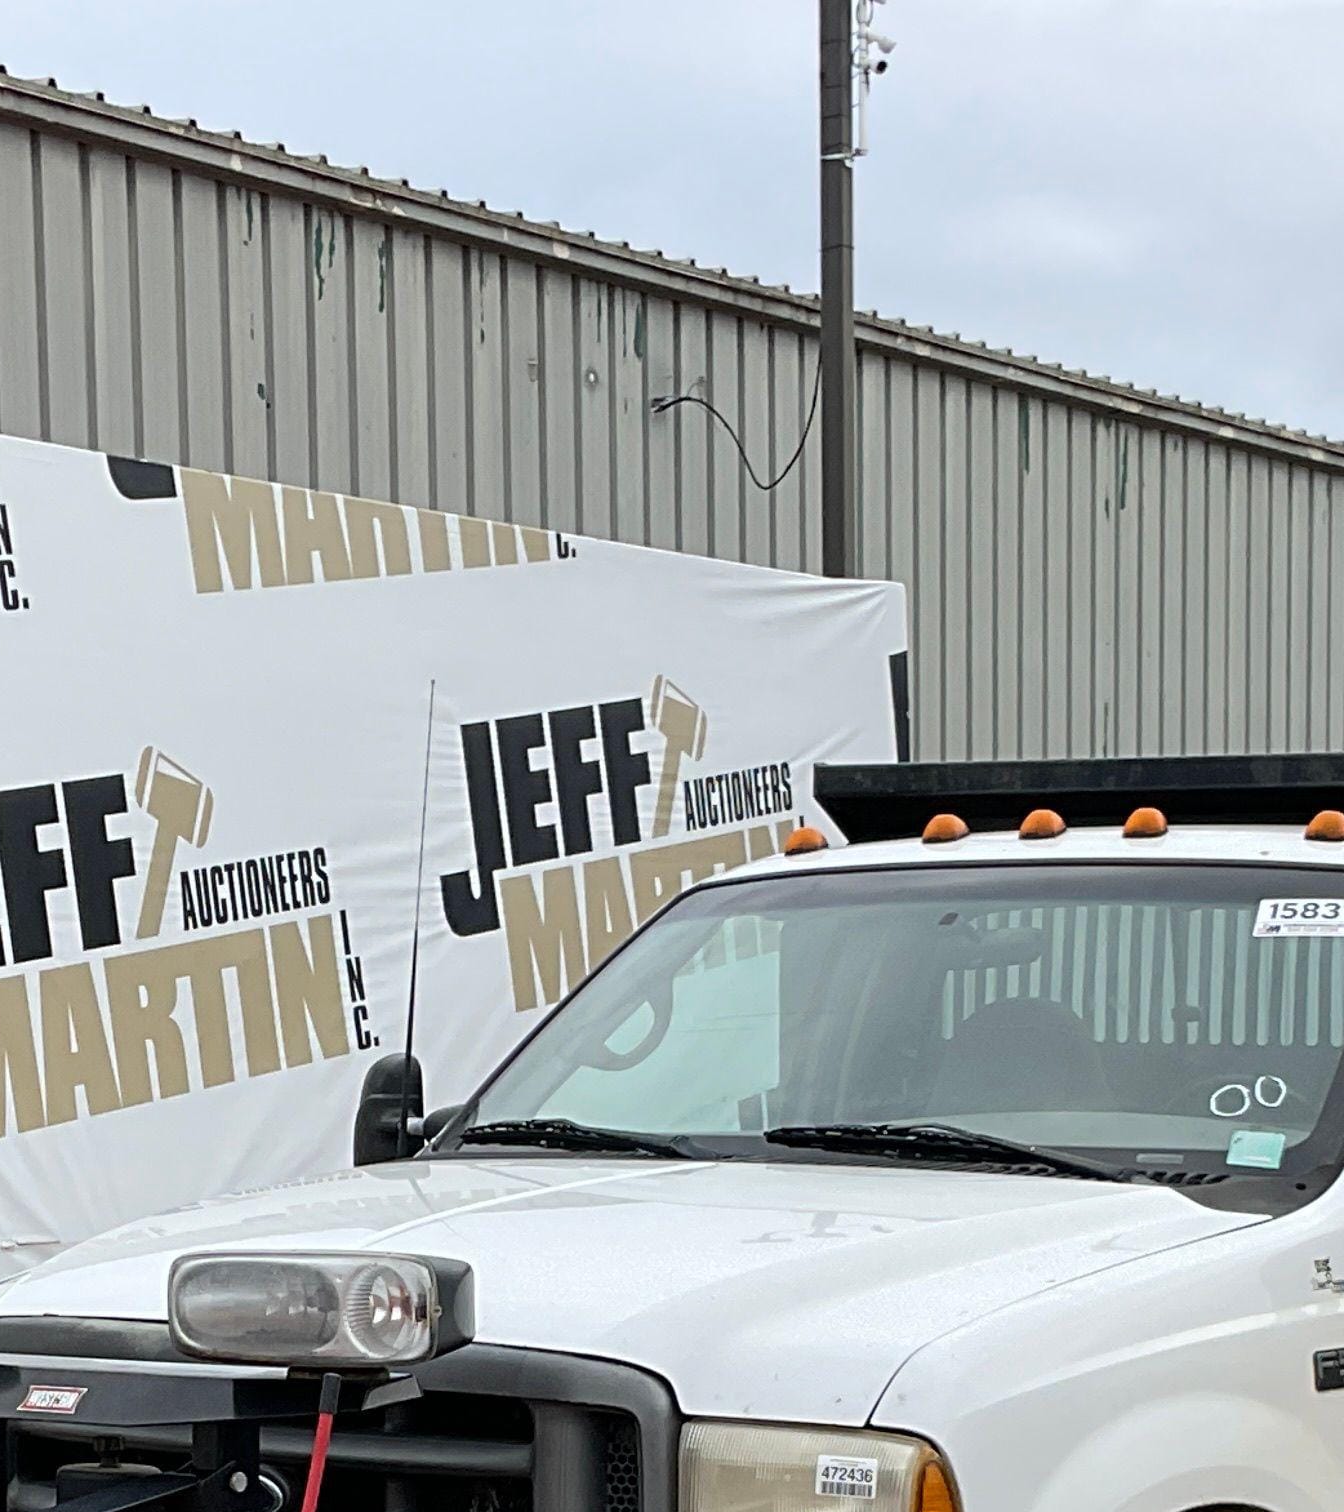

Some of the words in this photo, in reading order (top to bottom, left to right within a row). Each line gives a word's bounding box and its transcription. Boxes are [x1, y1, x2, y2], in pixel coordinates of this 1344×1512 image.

[180, 466, 551, 594] MAR
[440, 698, 652, 938] JEFF
[683, 762, 793, 831] AUCTIONEERS
[180, 847, 331, 931] AUCTIONEERS
[499, 819, 794, 1013] MAR
[1270, 902, 1341, 919] 1583
[341, 910, 380, 1050] INC.
[821, 1466, 874, 1483] 472436
